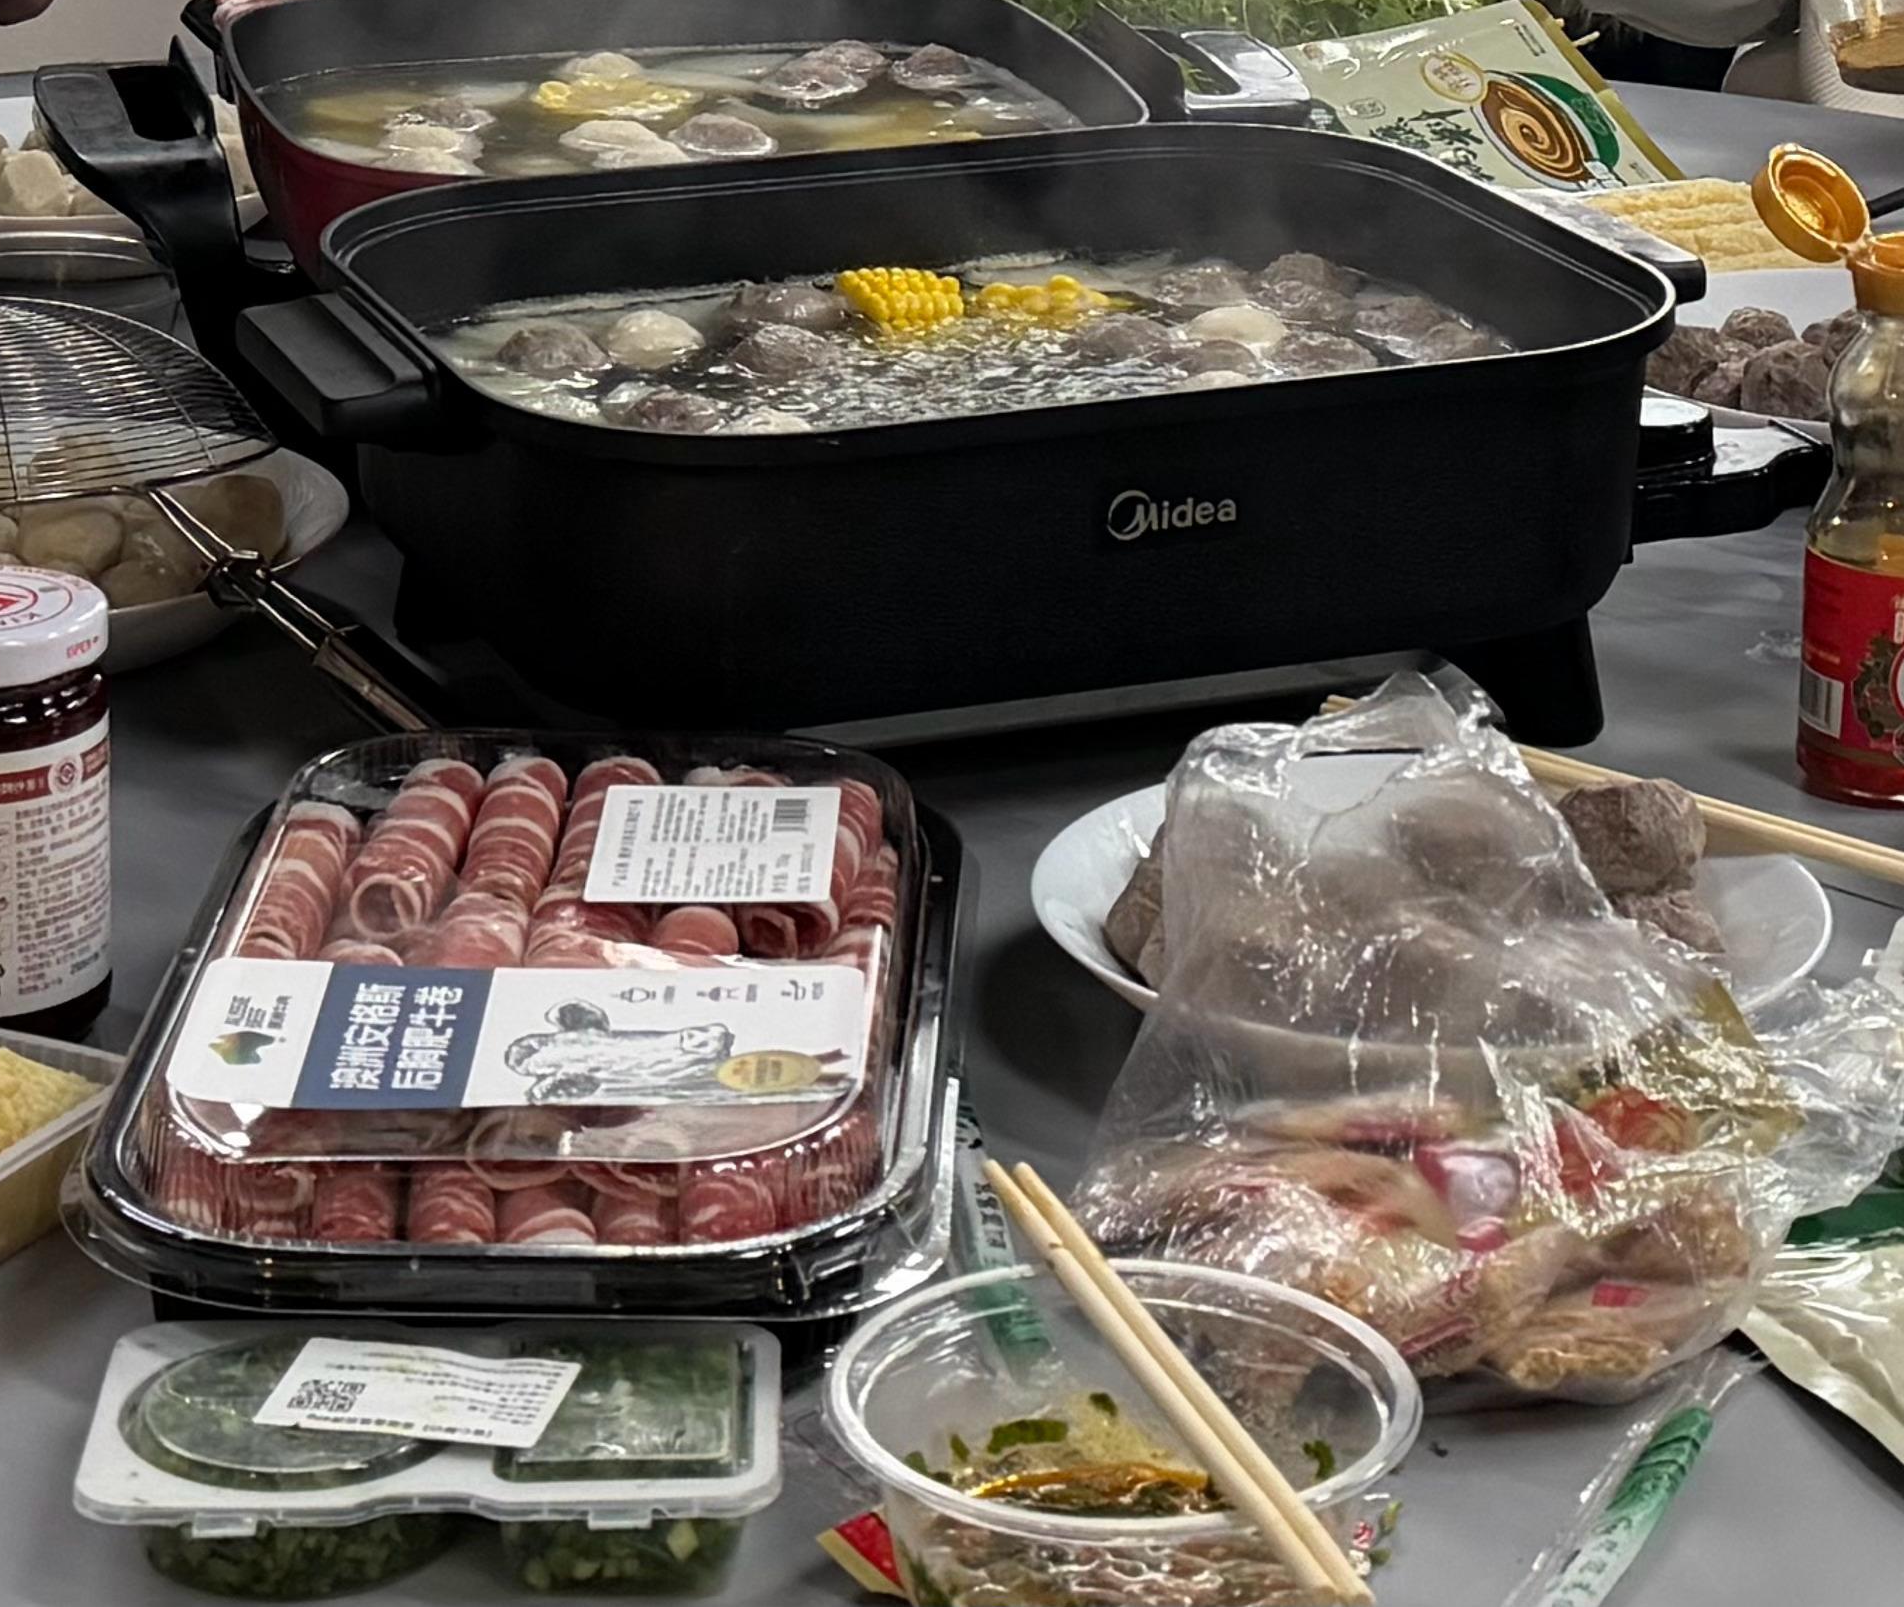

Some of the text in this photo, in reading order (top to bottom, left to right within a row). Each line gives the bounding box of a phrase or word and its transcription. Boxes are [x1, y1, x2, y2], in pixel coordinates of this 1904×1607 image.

[1107, 489, 1237, 541] Midea
[329, 982, 407, 1091] 澳洲安格斯
[391, 985, 464, 1091] 后胸肥牛卷
